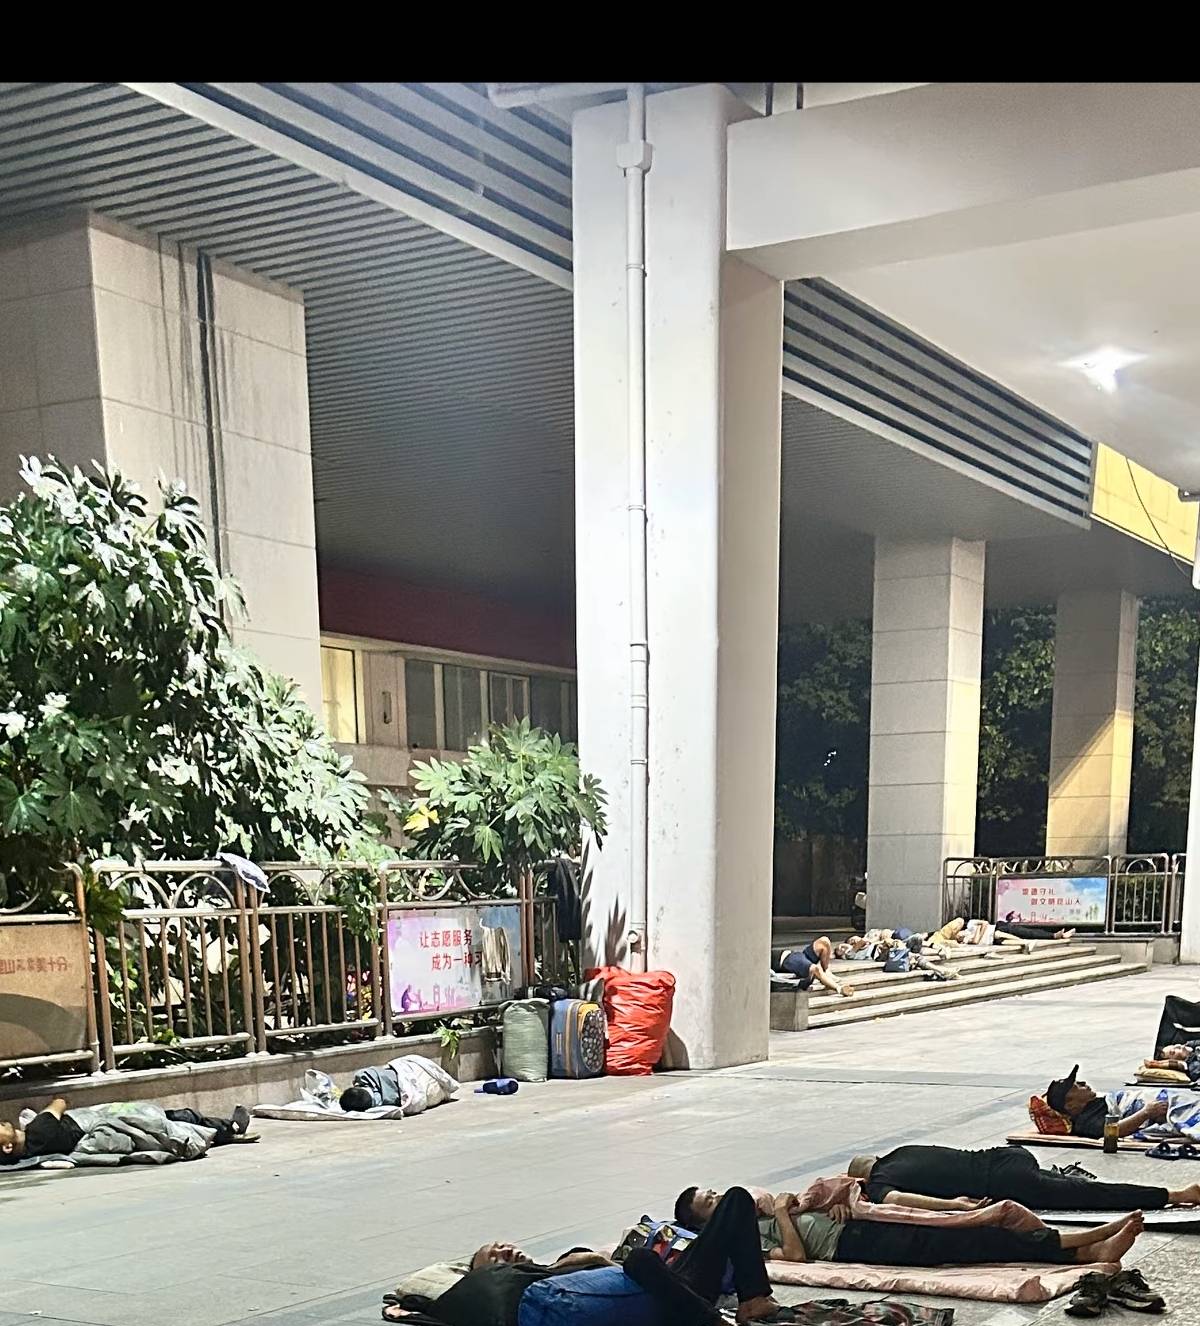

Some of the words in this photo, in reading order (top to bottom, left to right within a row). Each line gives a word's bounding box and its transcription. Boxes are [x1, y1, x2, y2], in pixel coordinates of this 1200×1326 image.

[420, 929, 472, 948] 让志愿服务
[432, 951, 483, 970] 成为一种习
